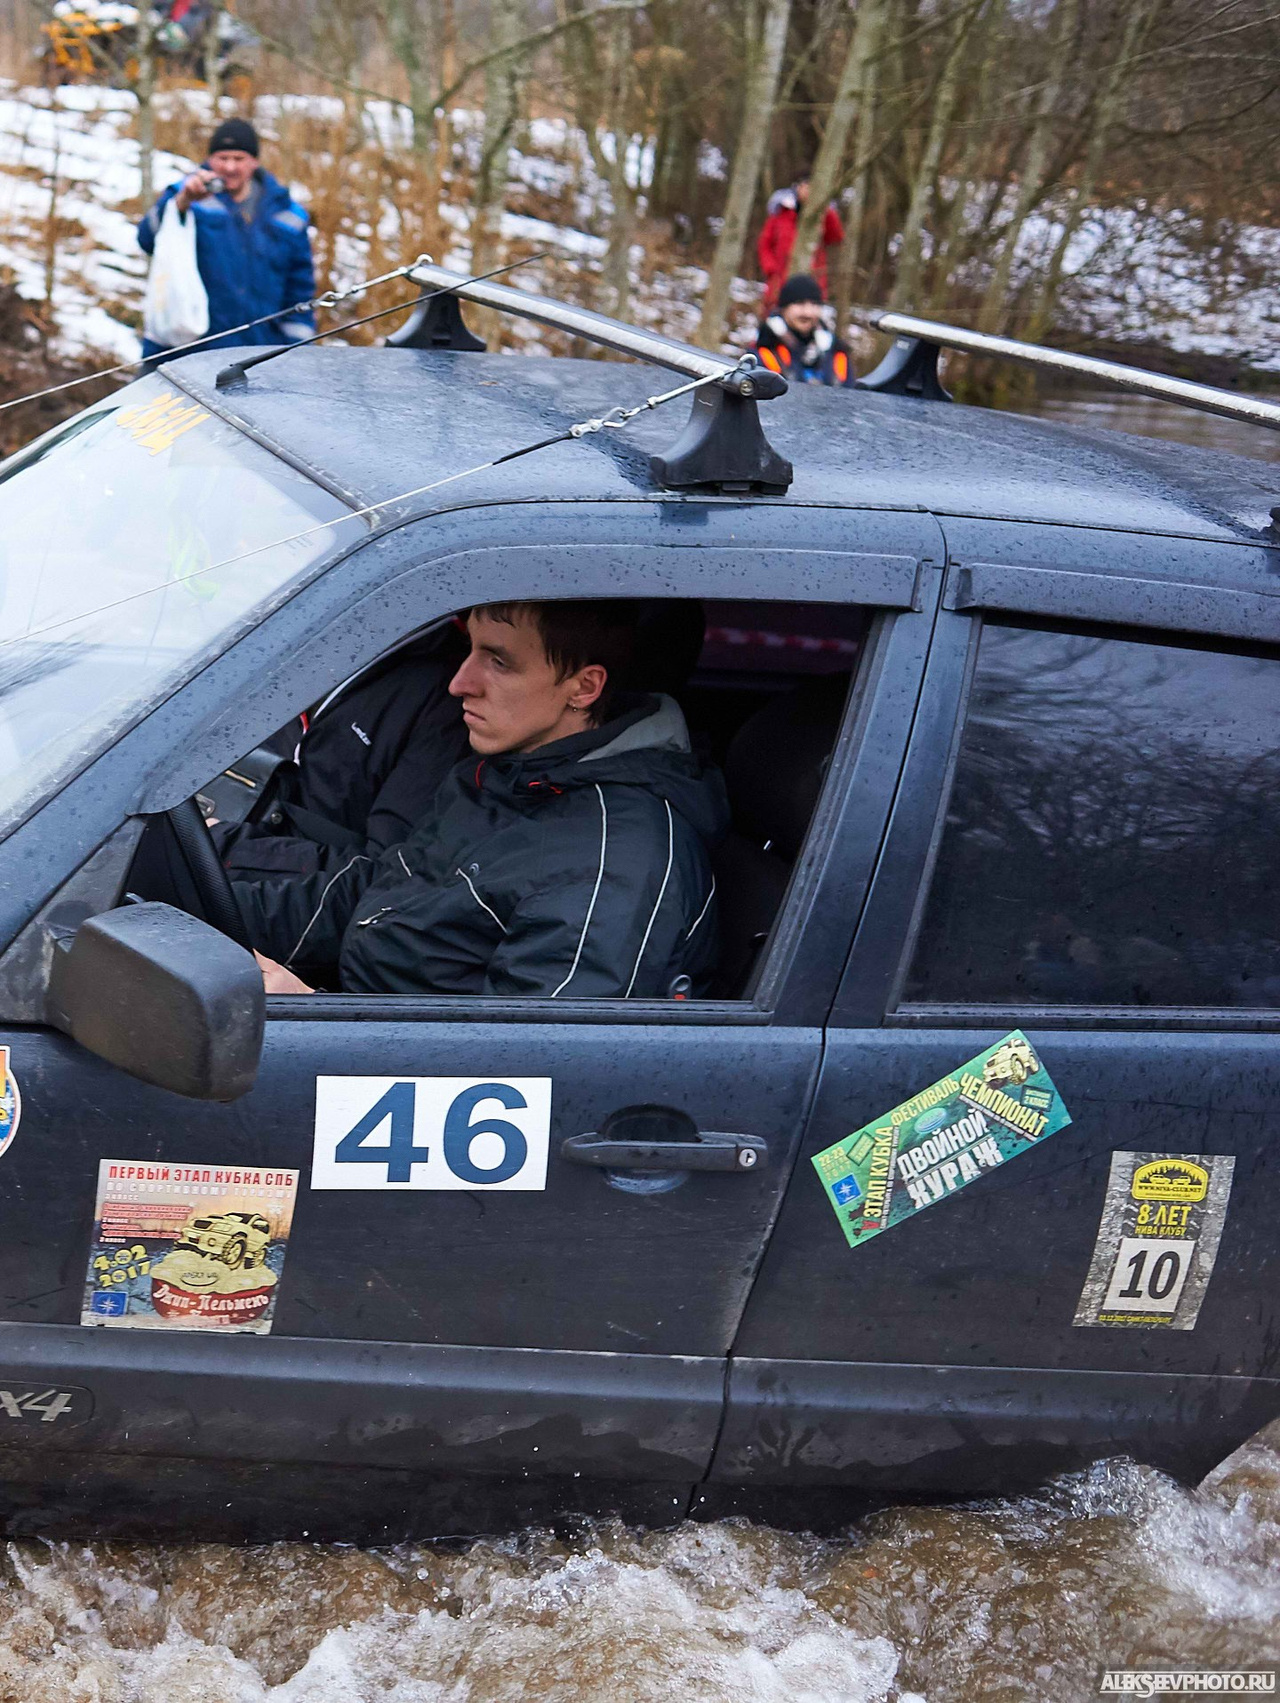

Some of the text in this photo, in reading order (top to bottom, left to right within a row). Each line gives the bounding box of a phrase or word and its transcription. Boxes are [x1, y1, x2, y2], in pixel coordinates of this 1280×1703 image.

[890, 1078, 960, 1126] ФЕСТИВАЛЬ
[959, 1072, 1050, 1136] ЧЕМПИОНАТ
[334, 1081, 528, 1185] 46
[870, 1126, 894, 1177] КУБКА
[896, 1108, 990, 1184] ДВОЙНОЙ
[109, 1165, 294, 1187] ПЕРВЫЙ ЭТАП КУБКА СПБ
[863, 1175, 889, 1218] ЭТАП
[1135, 1226, 1187, 1236] НИВА КЛУБУ
[1137, 1204, 1192, 1226] 8 ЛЕТ
[93, 1244, 148, 1271] 4.02
[99, 1261, 151, 1287] 2017
[1118, 1250, 1181, 1300] 10
